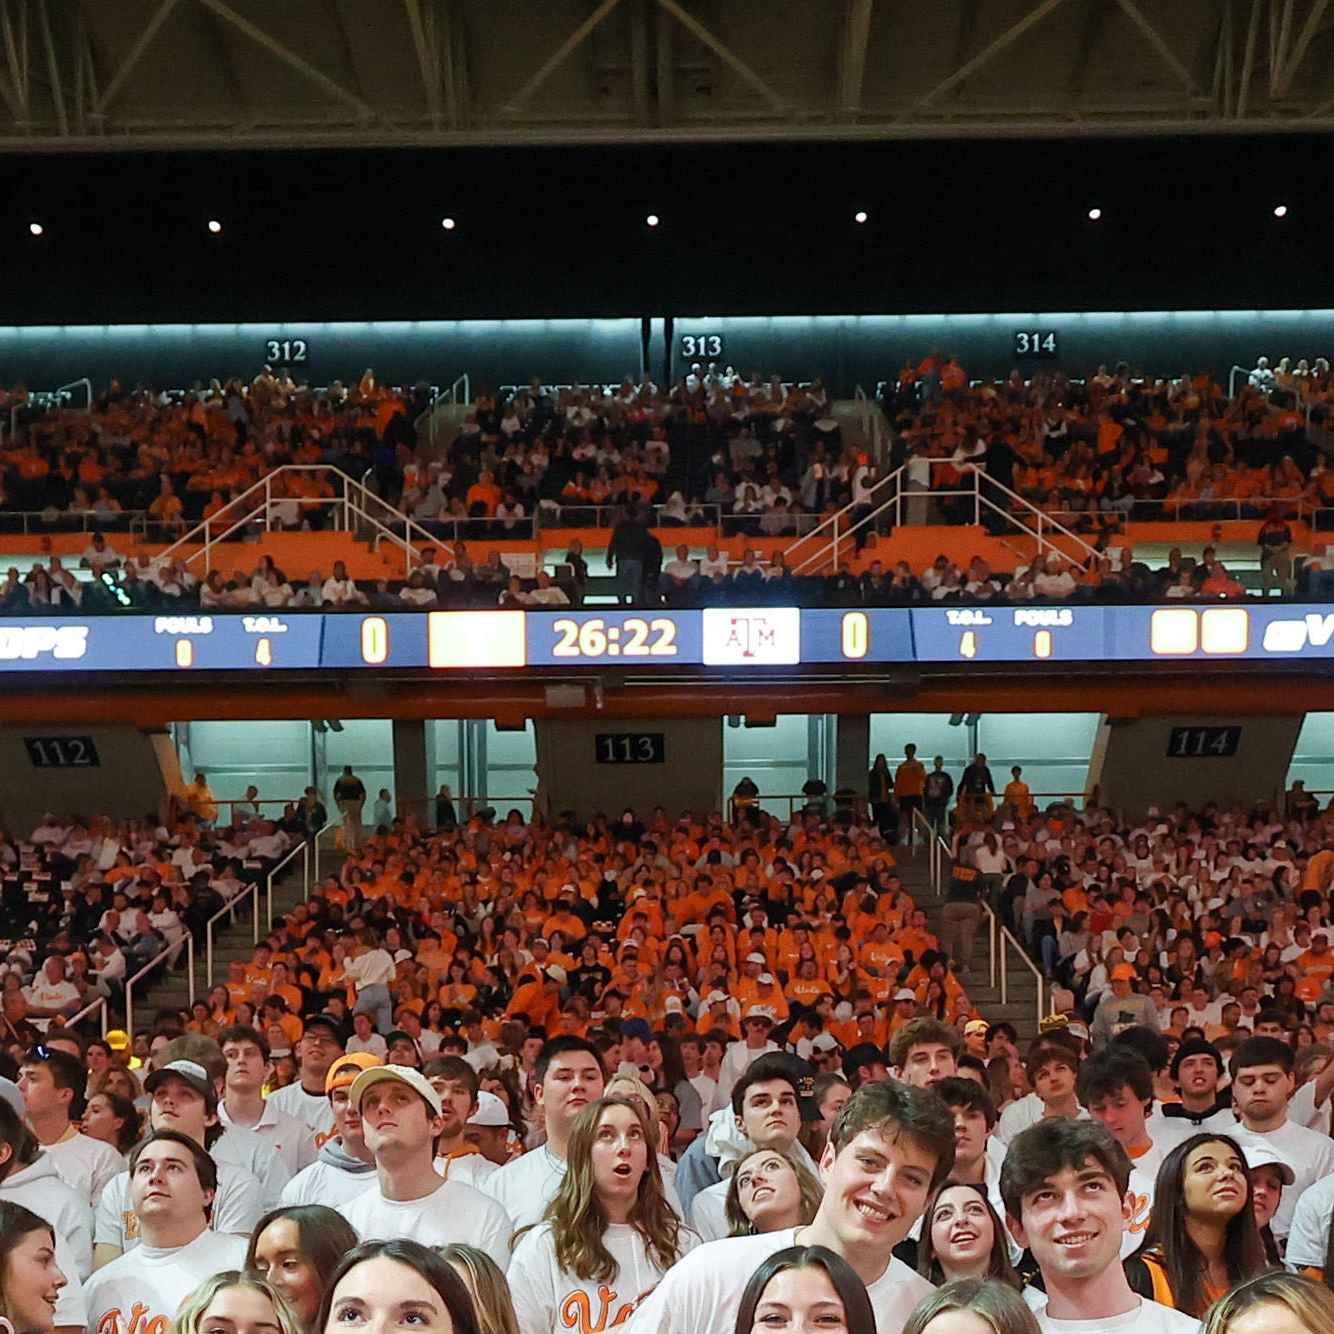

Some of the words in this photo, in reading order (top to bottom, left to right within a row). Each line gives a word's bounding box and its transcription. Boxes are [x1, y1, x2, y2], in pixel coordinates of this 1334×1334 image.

[267, 339, 306, 361] 312
[681, 335, 722, 358] 313
[1016, 332, 1056, 353] 314
[155, 616, 214, 635] FOULS
[1014, 609, 1074, 627] FOULS
[362, 617, 388, 664] 0
[552, 619, 678, 657] 26:22
[841, 612, 868, 658] 0
[959, 630, 976, 658] 4
[254, 638, 272, 667] 4
[33, 740, 92, 766] 112
[602, 735, 656, 763] 113
[1175, 730, 1230, 756] 114
